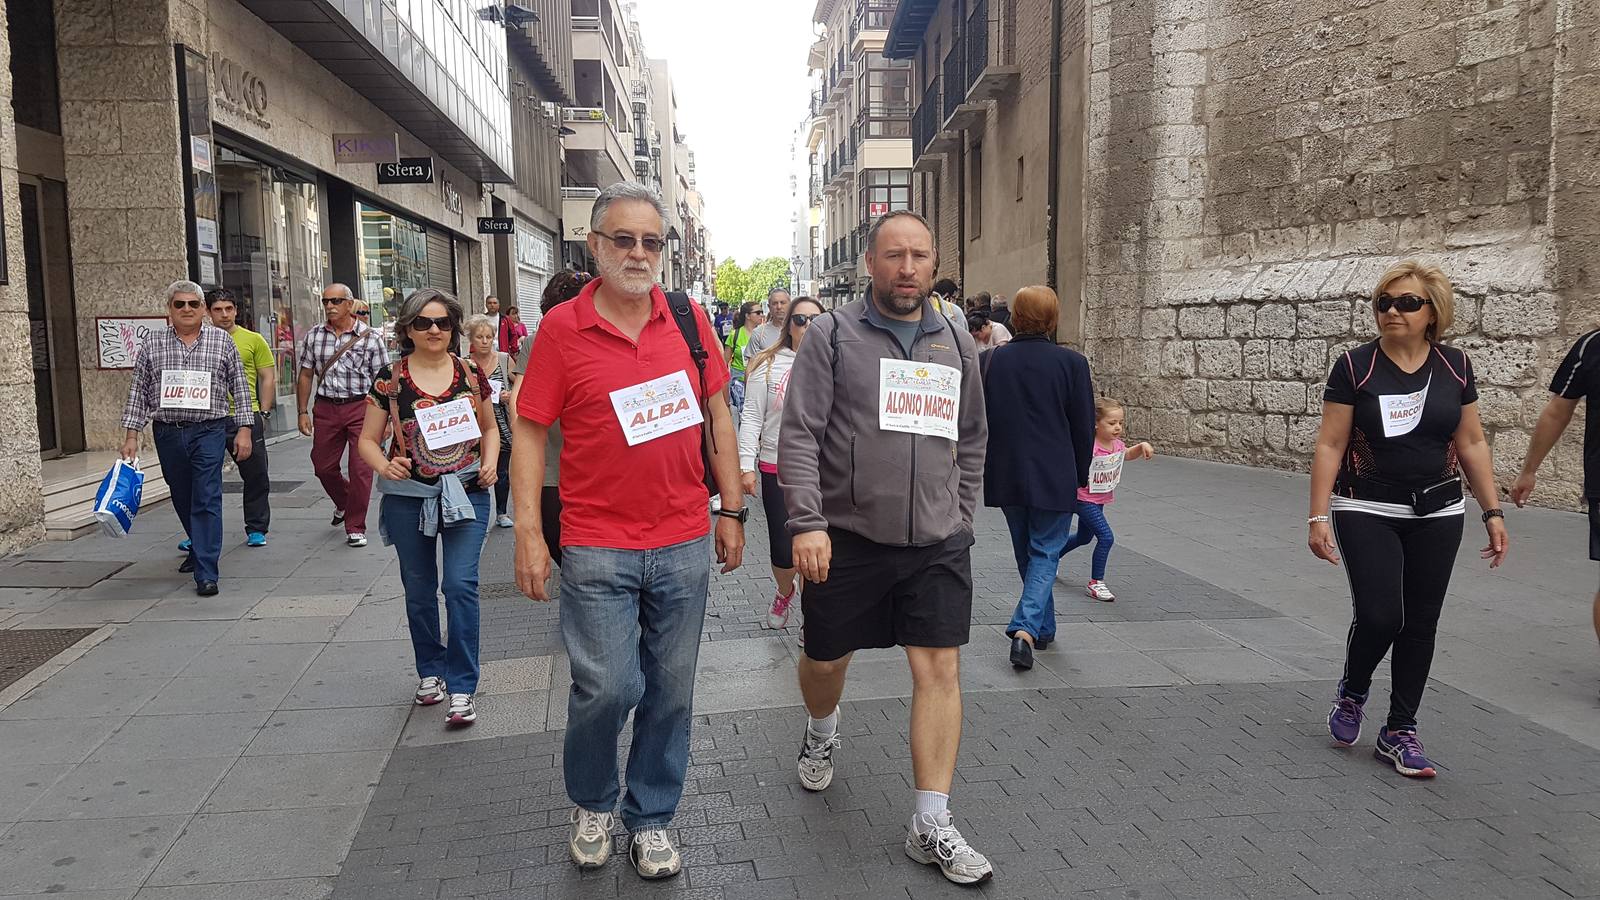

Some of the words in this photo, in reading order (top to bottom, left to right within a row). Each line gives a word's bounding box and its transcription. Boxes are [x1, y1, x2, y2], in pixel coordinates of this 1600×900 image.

[211, 51, 268, 117] KIKO
[337, 139, 396, 154] KIKO
[164, 386, 208, 399] LUENGO
[629, 397, 690, 428] ALBA
[885, 391, 922, 416] ALONSO
[923, 394, 955, 421] MARCOS
[426, 413, 470, 433] ALBA
